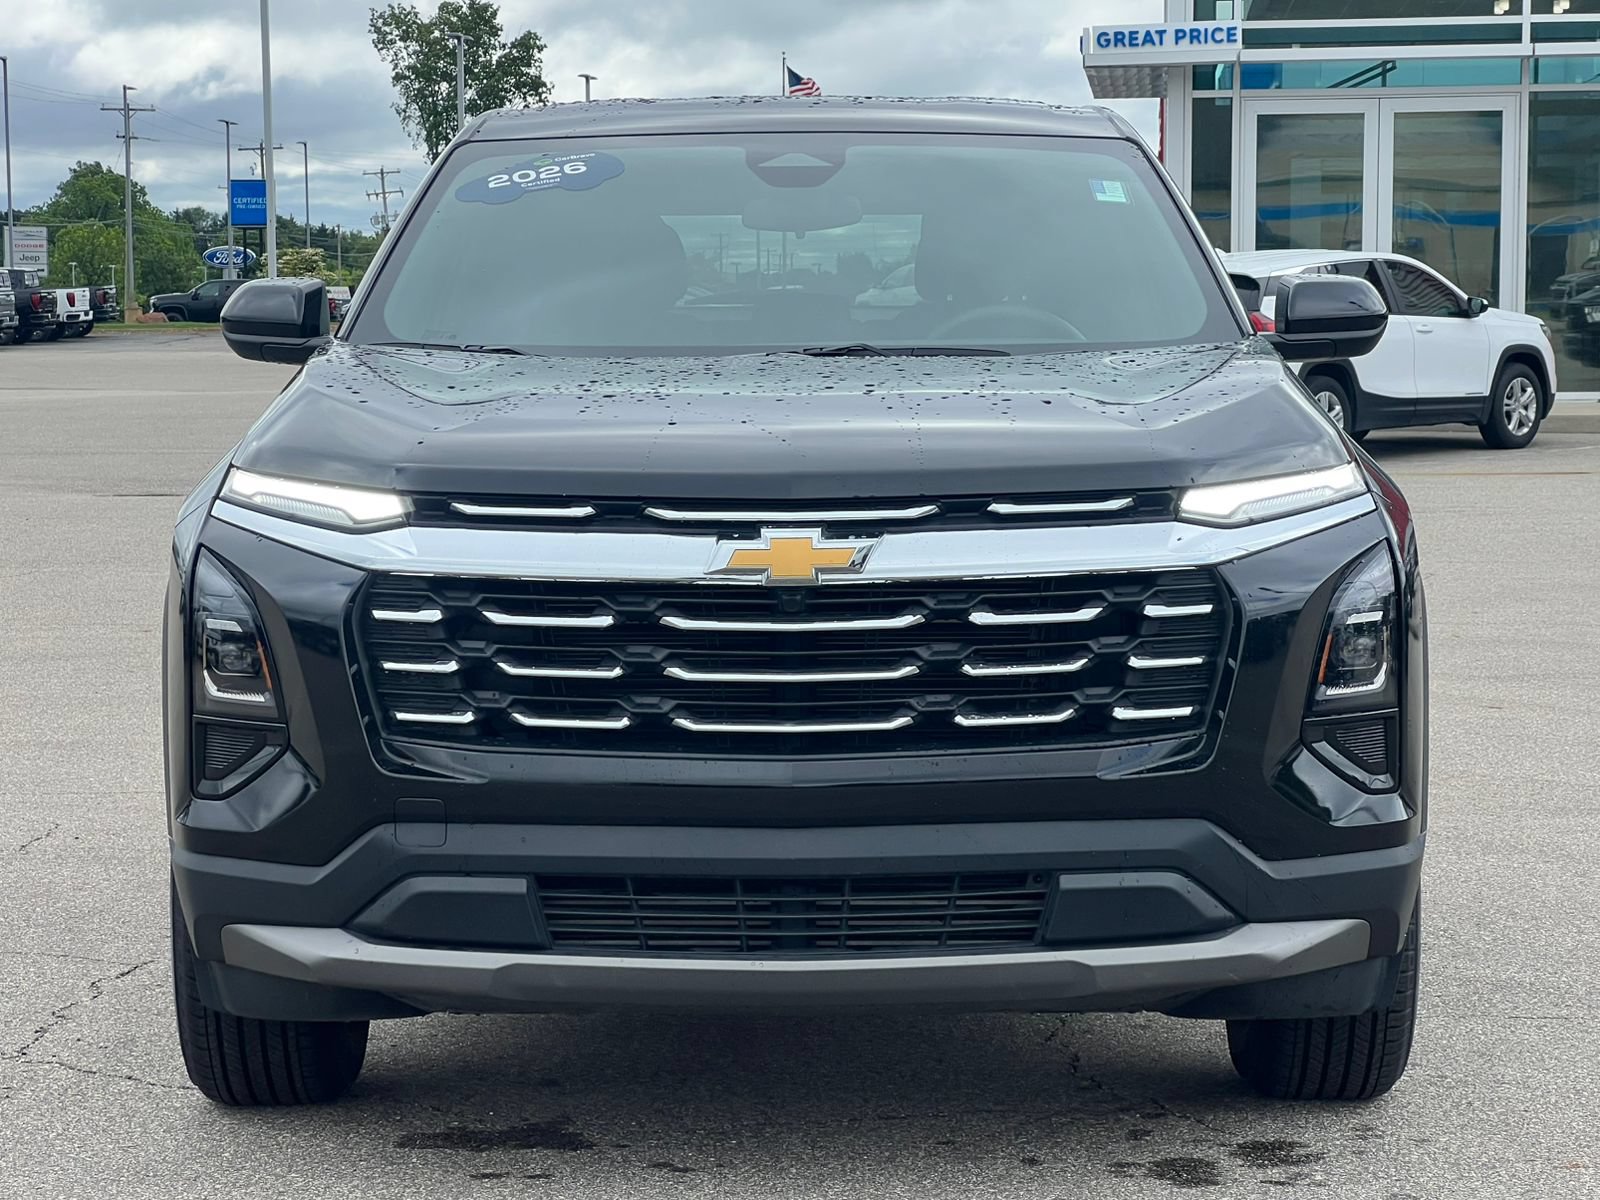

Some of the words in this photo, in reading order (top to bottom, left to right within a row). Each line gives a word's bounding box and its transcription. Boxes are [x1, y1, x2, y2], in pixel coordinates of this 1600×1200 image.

[1097, 29, 1167, 48] GREAT
[1174, 26, 1238, 46] PRICE
[487, 162, 587, 189] 2026
[520, 177, 560, 188] Certified
[19, 253, 40, 263] Jeep
[213, 250, 243, 264] Fod
